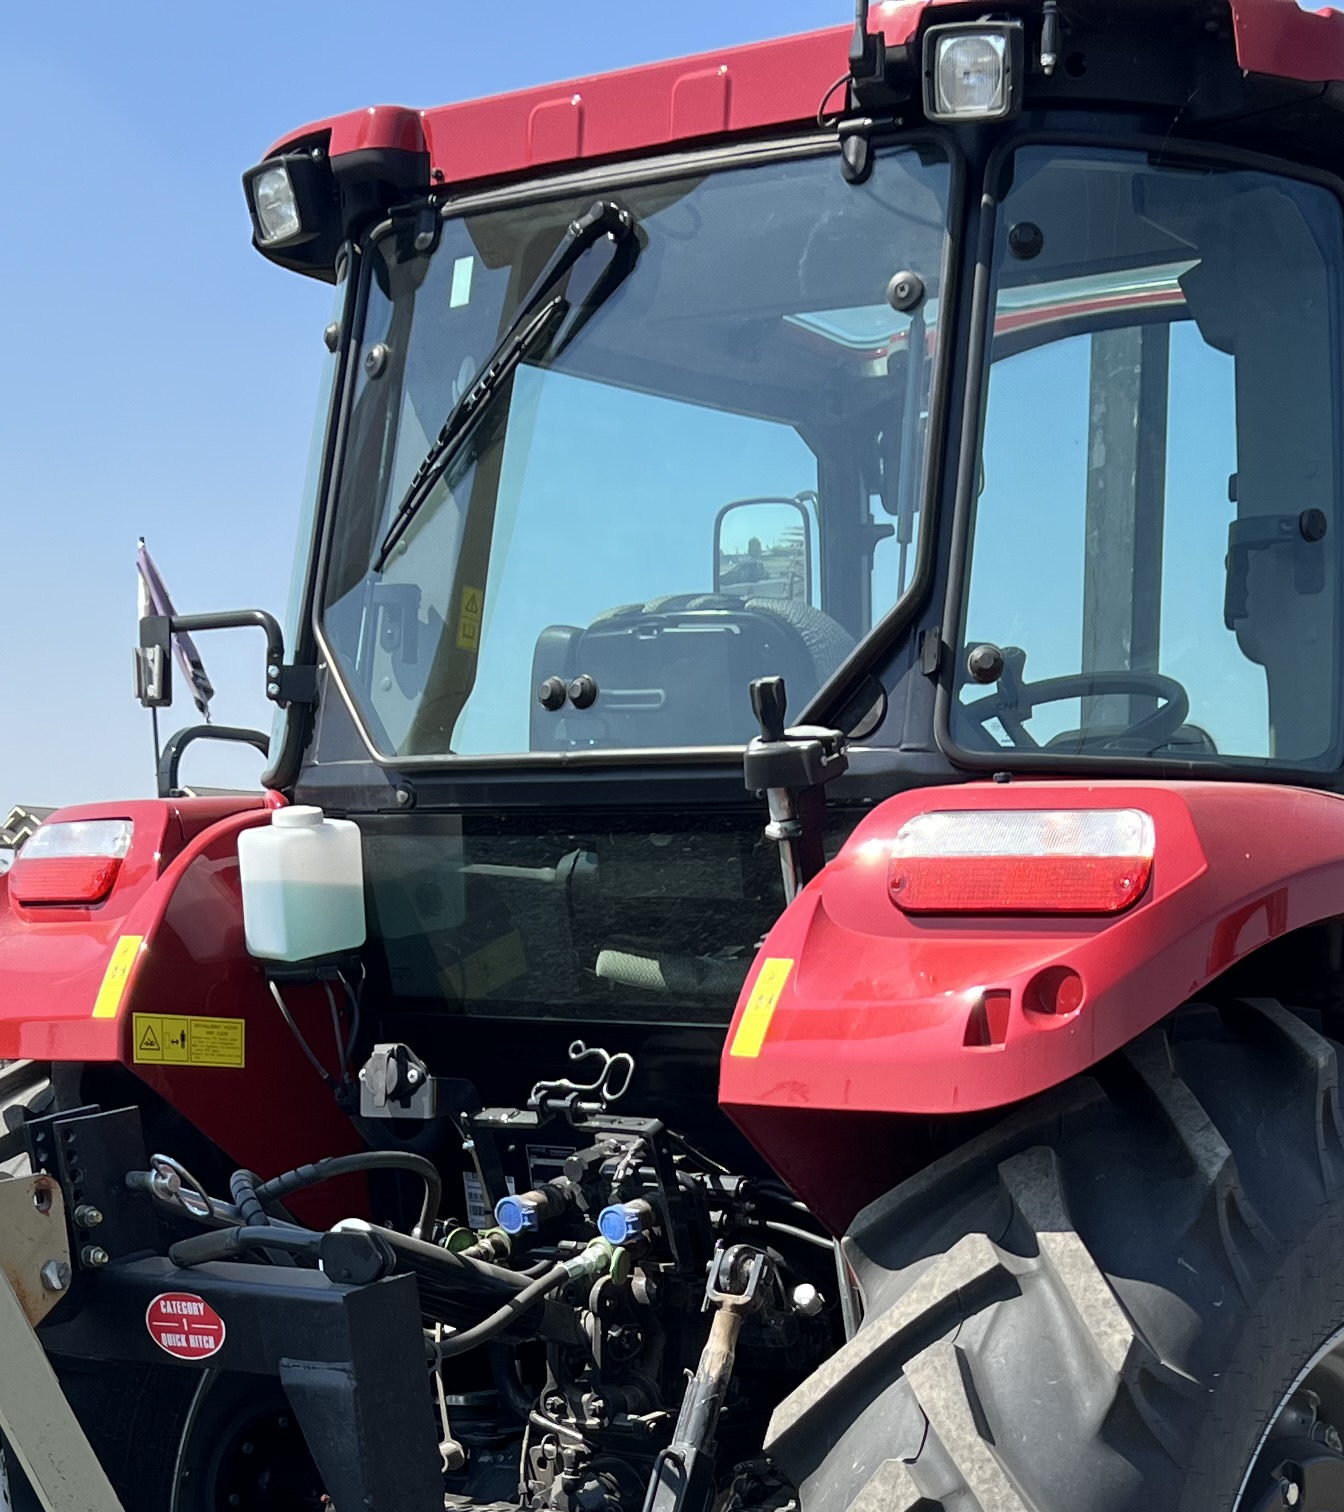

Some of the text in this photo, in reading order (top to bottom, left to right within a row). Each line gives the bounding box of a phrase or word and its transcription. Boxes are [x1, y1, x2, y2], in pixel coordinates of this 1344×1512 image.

[159, 1299, 205, 1316] CATEGORY
[182, 1317, 188, 1332] 1
[160, 1332, 216, 1349] QUICK HITCH
